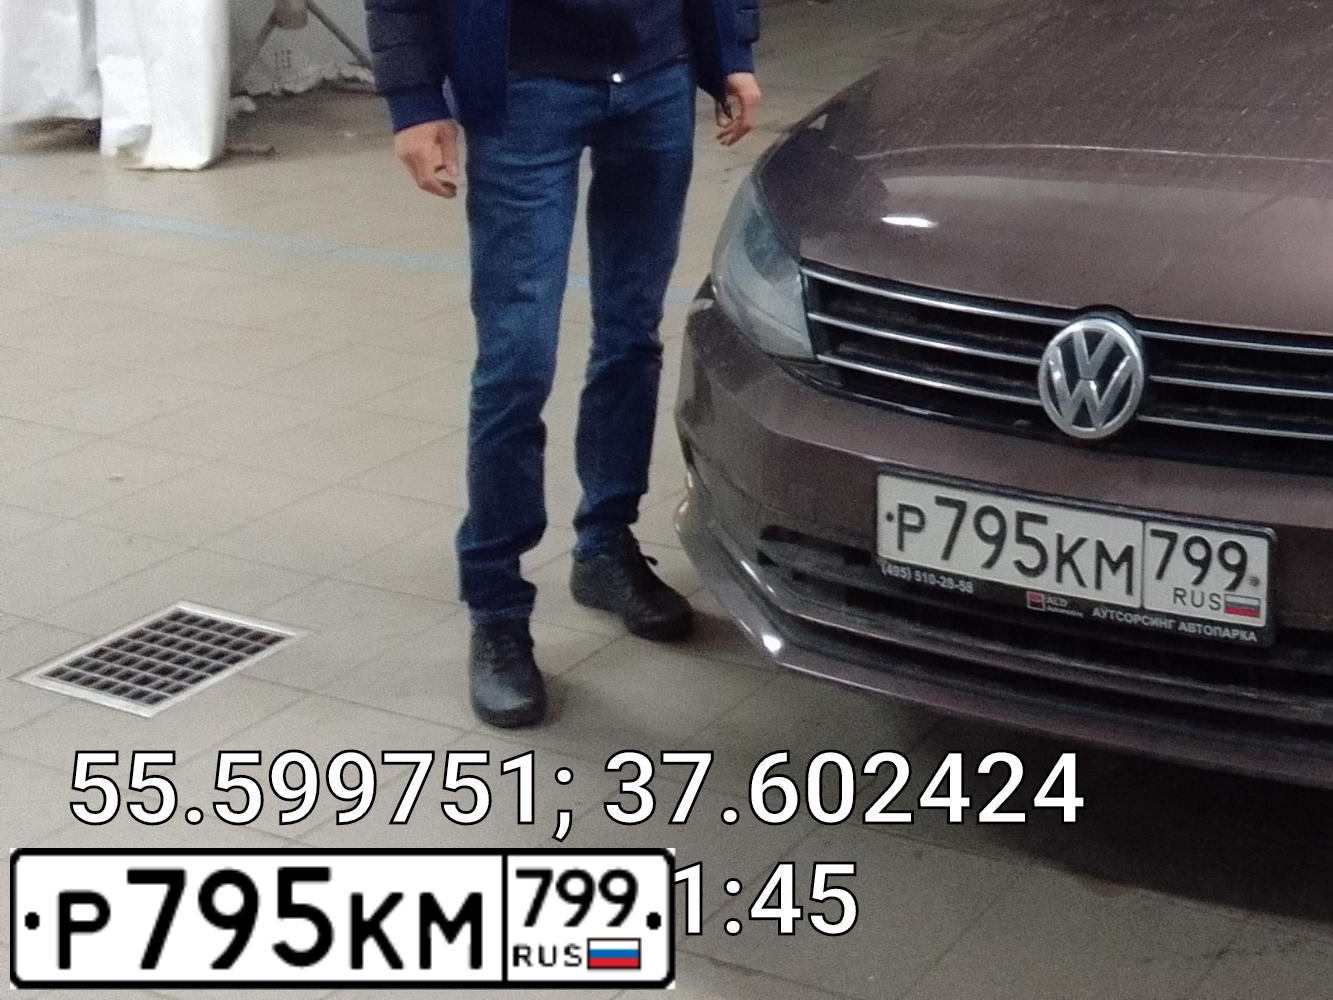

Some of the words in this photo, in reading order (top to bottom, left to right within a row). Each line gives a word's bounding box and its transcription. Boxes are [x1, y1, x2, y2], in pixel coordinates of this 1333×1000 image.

[881, 562, 911, 582] (495)
[1150, 529, 1248, 591] 799
[1172, 587, 1222, 611] RUS
[1092, 606, 1176, 629] АУТСОРСИНГ
[1177, 620, 1258, 642] АВТОПАРКА
